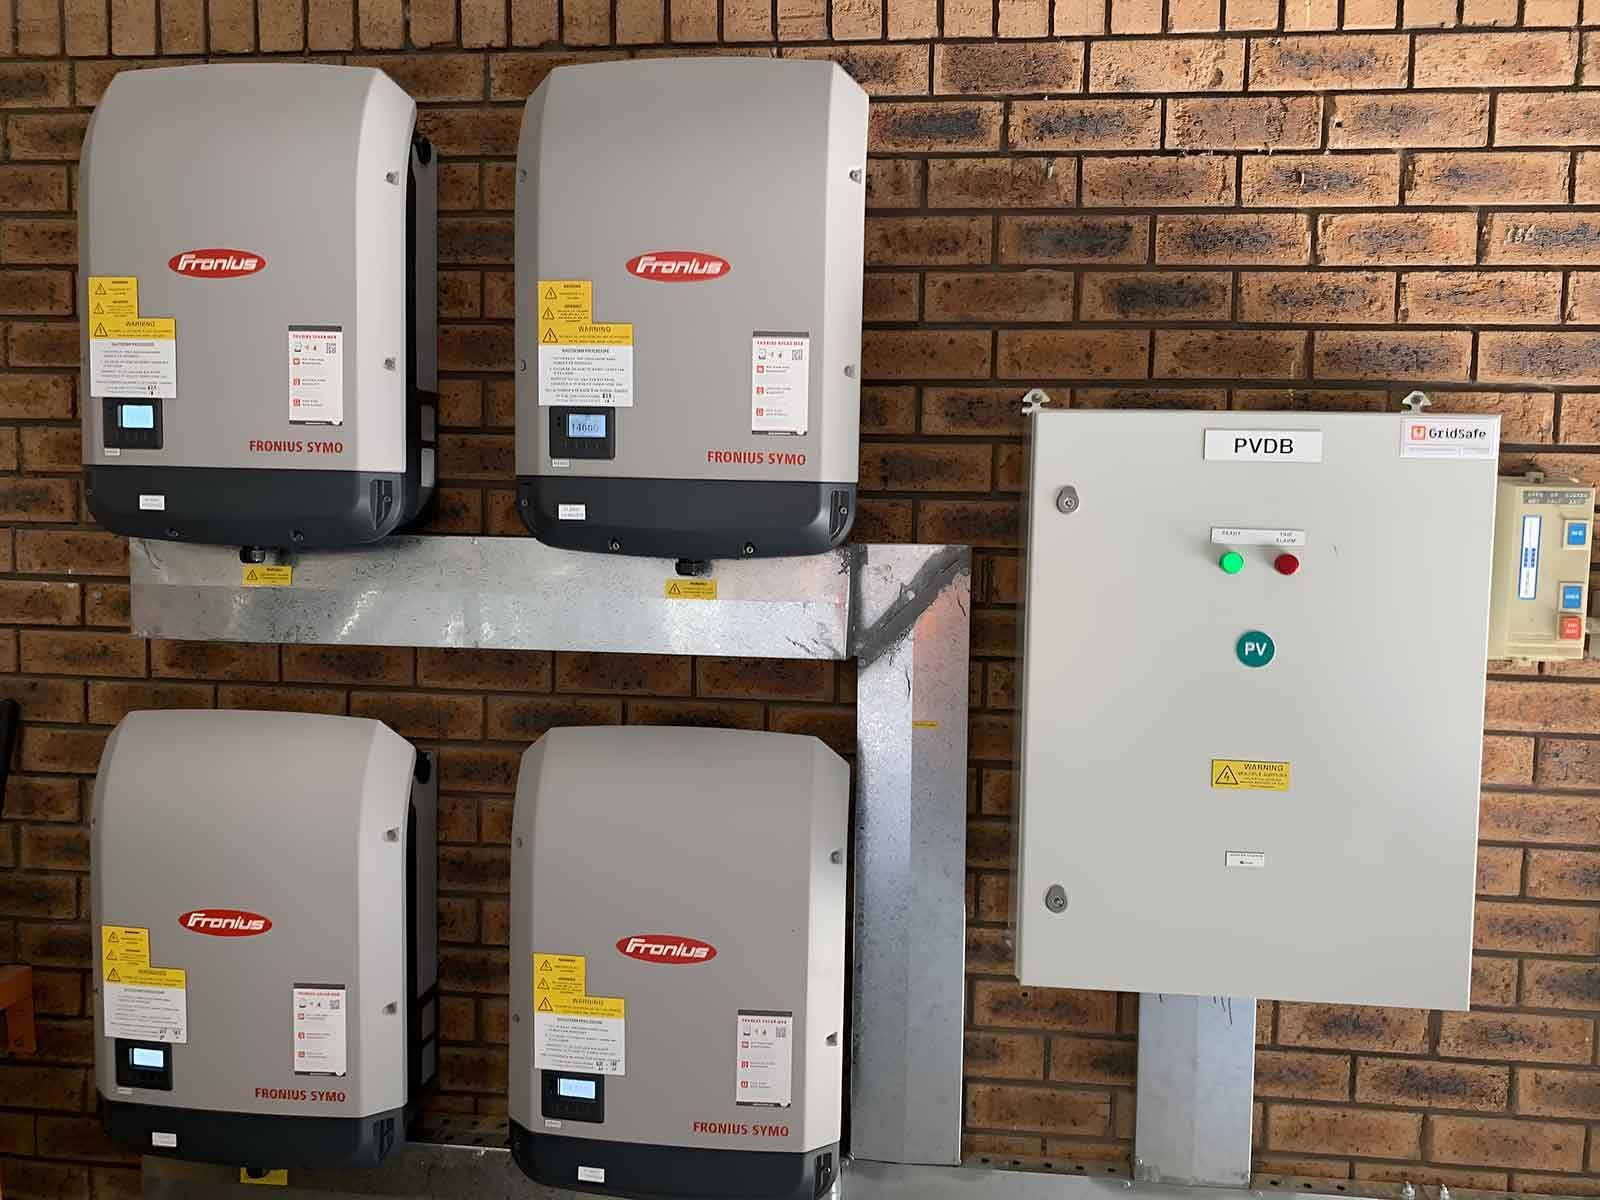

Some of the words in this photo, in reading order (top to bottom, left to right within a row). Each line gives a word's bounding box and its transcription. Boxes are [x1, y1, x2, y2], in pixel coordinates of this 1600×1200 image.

[177, 253, 258, 271] Fronius
[637, 257, 722, 274] Fronius
[1428, 427, 1487, 440] GridSafe
[249, 440, 303, 453] FRONIUS
[307, 441, 344, 454] SYMO
[1234, 437, 1294, 455] PVDB
[707, 450, 764, 465] FRONIUS
[768, 452, 806, 466] SYMO
[1245, 641, 1267, 656] PV
[187, 913, 265, 932] Fronius
[625, 938, 710, 958] Fronius
[255, 1088, 308, 1101] FRONIUS
[311, 1090, 346, 1103] SYMO
[692, 1122, 748, 1137] FRONIUS
[752, 1124, 790, 1138] SYMO
